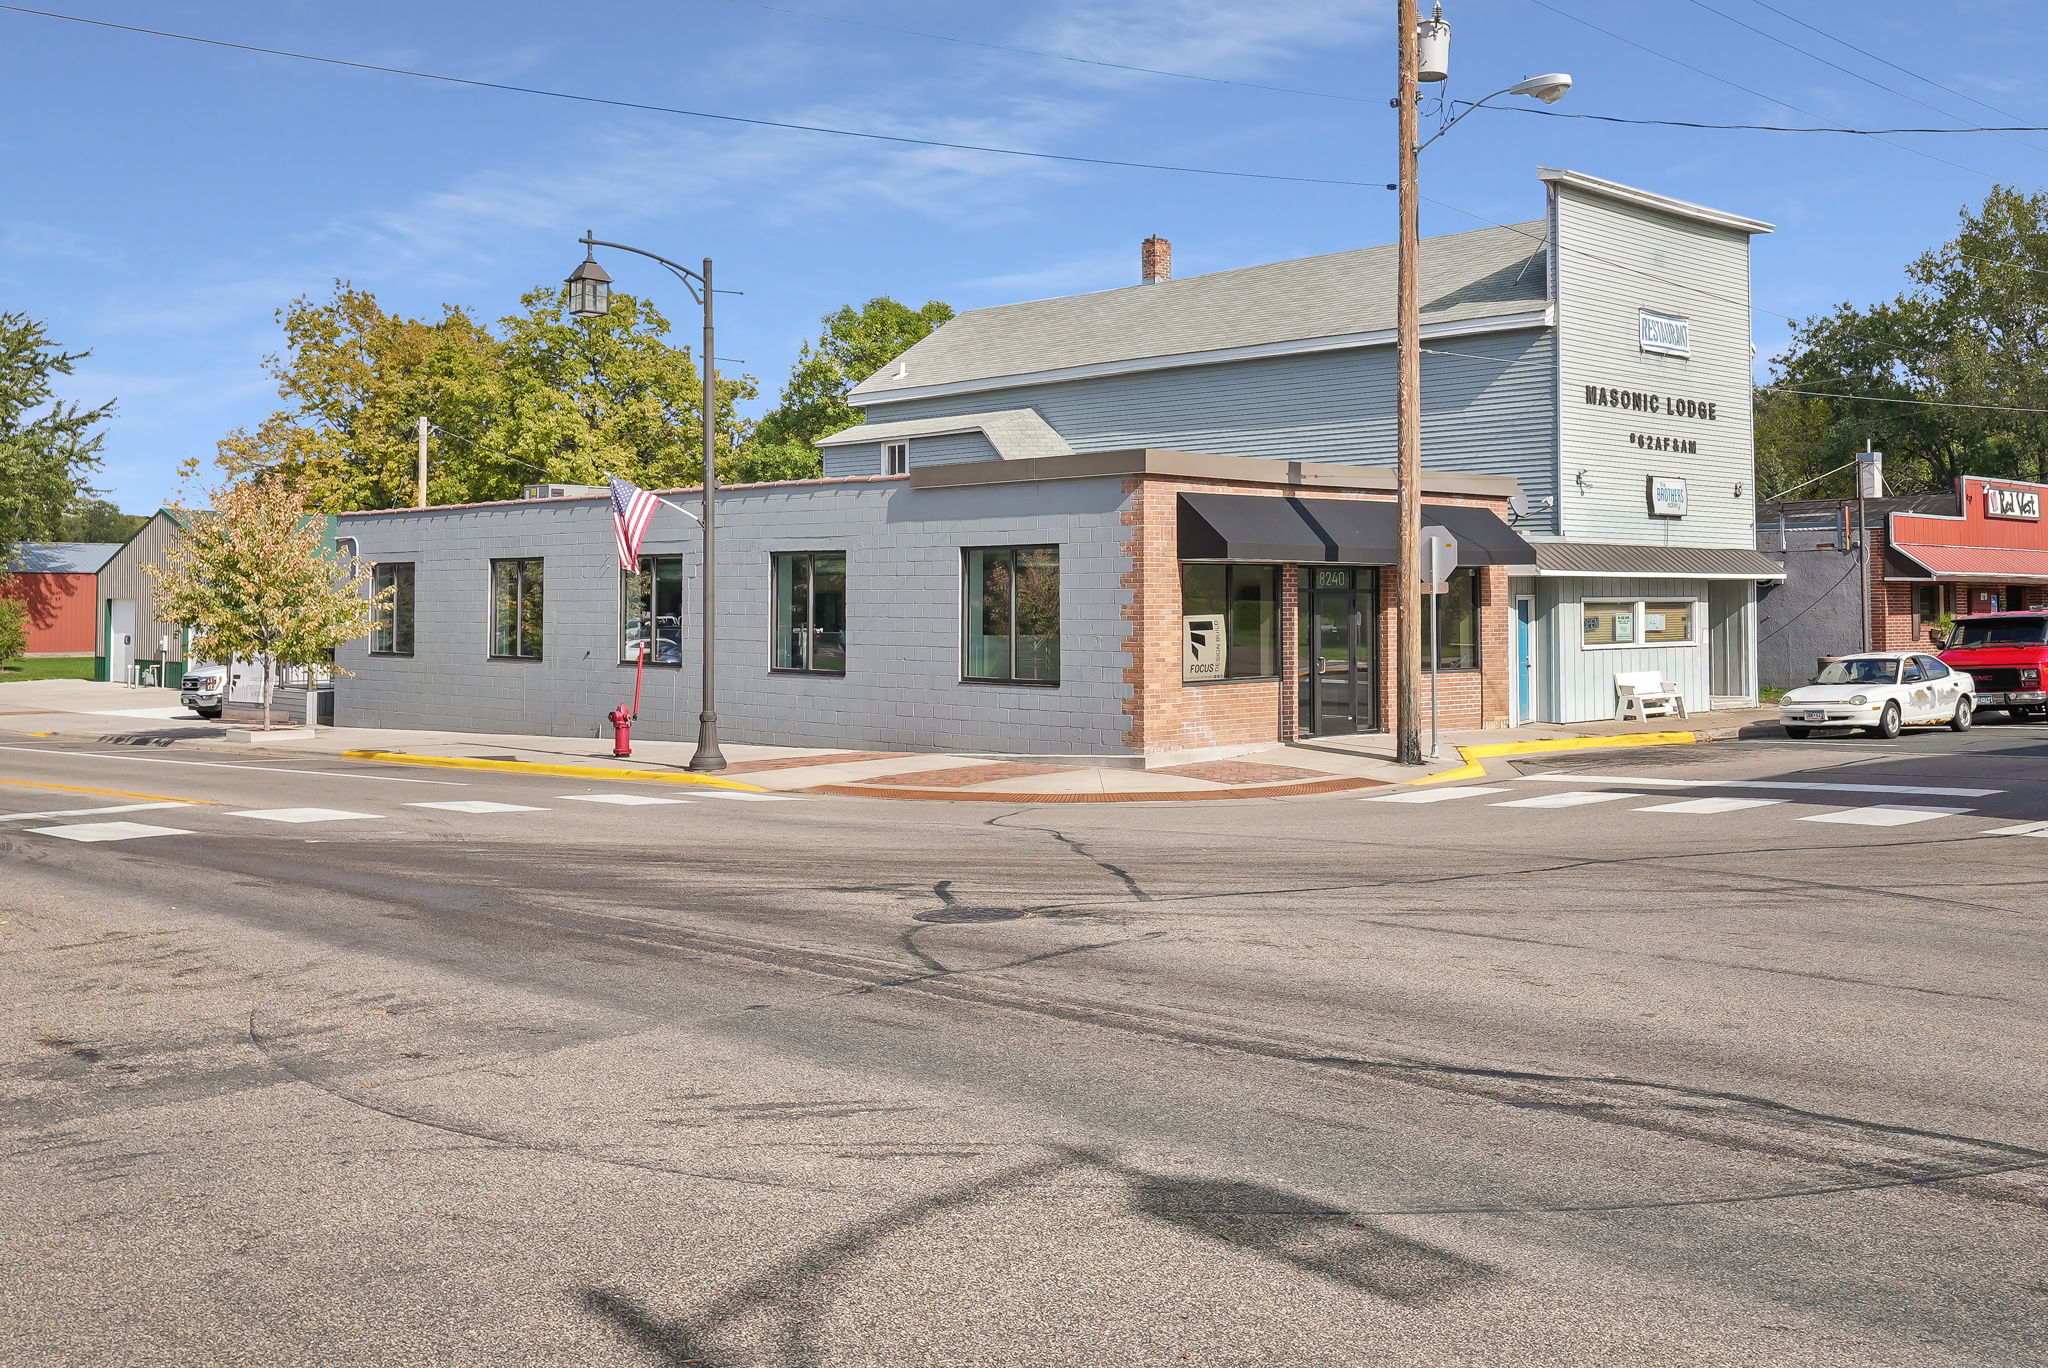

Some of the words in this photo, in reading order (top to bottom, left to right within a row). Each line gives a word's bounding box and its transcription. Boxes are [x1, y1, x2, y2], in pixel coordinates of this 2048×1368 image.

[1642, 317, 1688, 348] RESTAURANT
[1585, 385, 1660, 413] MASONIC
[1666, 396, 1717, 420] LODGE
[1656, 487, 1685, 503] BROTHERS
[1999, 489, 2015, 515] Red
[2016, 492, 2036, 516] Vest
[1319, 571, 1345, 586] 8240
[1190, 663, 1215, 674] FOCUS
